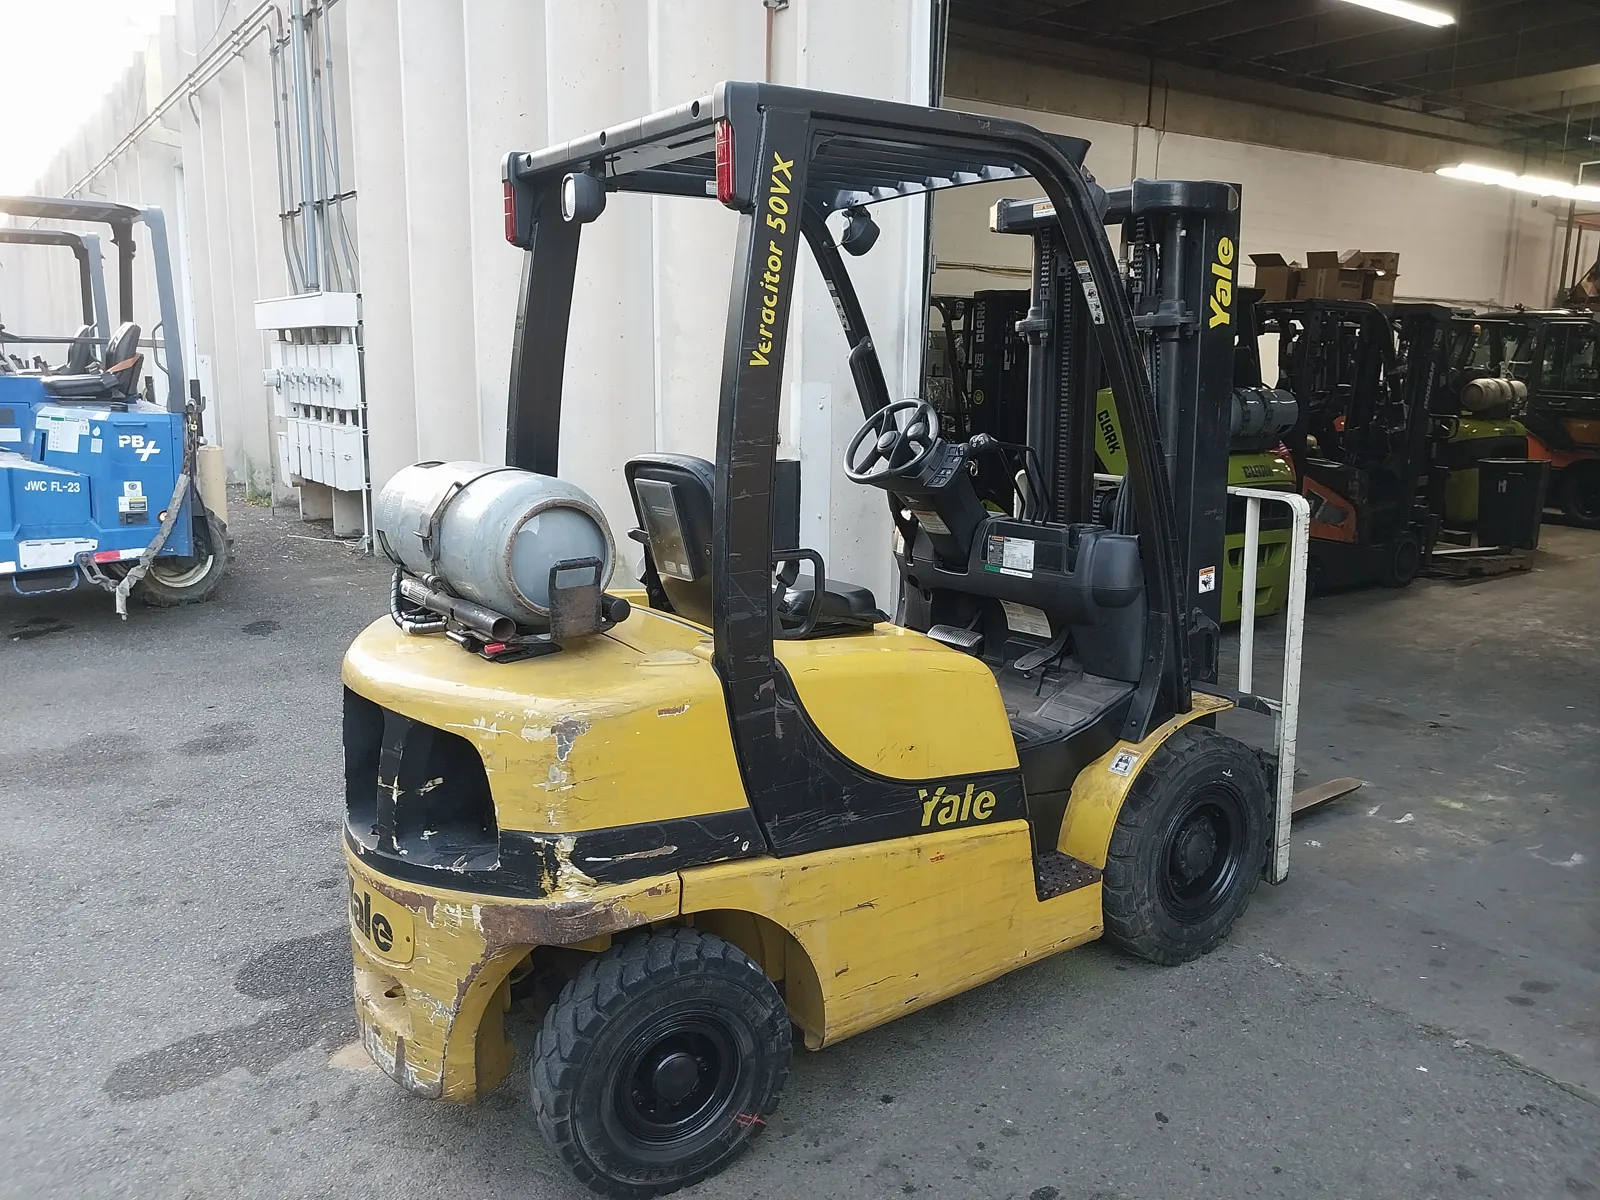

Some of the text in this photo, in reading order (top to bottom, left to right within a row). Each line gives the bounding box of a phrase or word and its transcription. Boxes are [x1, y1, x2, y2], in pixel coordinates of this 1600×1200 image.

[749, 152, 793, 367] Veracitor 50VX
[1209, 236, 1234, 329] Yale
[976, 301, 986, 343] CLARK
[1096, 409, 1121, 455] CLARK
[25, 481, 80, 492] JWC FL-23
[919, 783, 997, 827] Yale
